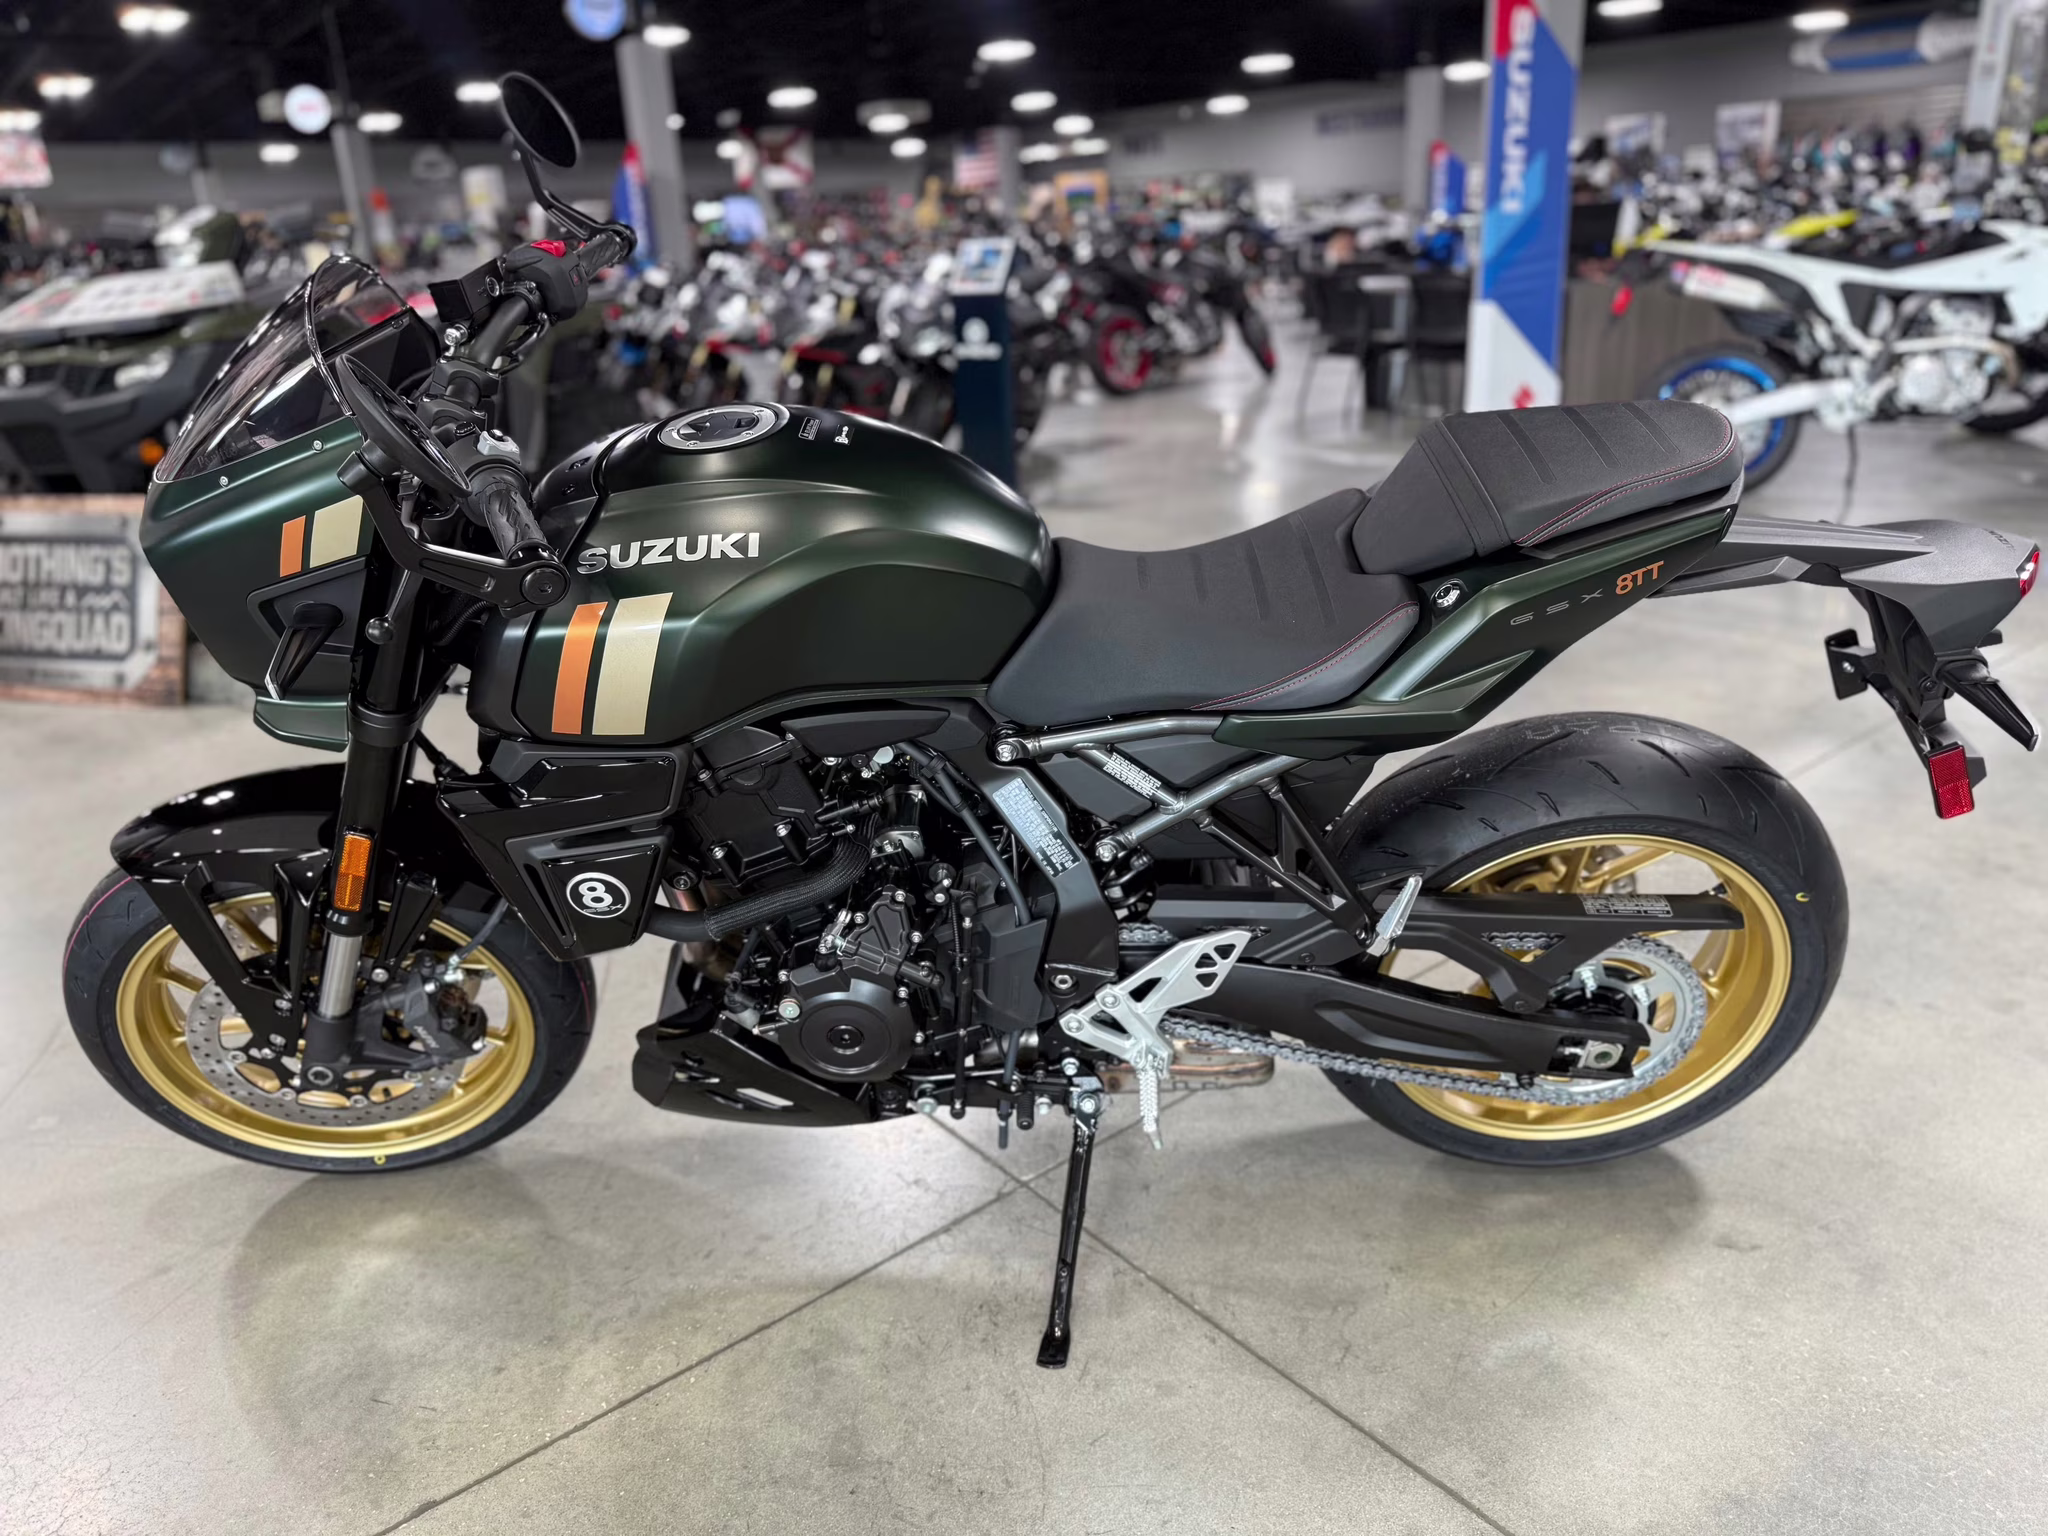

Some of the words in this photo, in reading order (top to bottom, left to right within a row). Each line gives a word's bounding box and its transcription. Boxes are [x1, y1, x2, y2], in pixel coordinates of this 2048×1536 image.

[1500, 3, 1537, 215] SUZUKI
[577, 532, 760, 575] SUZUKI
[1615, 560, 1665, 595] 8TT
[578, 881, 613, 908] 8
